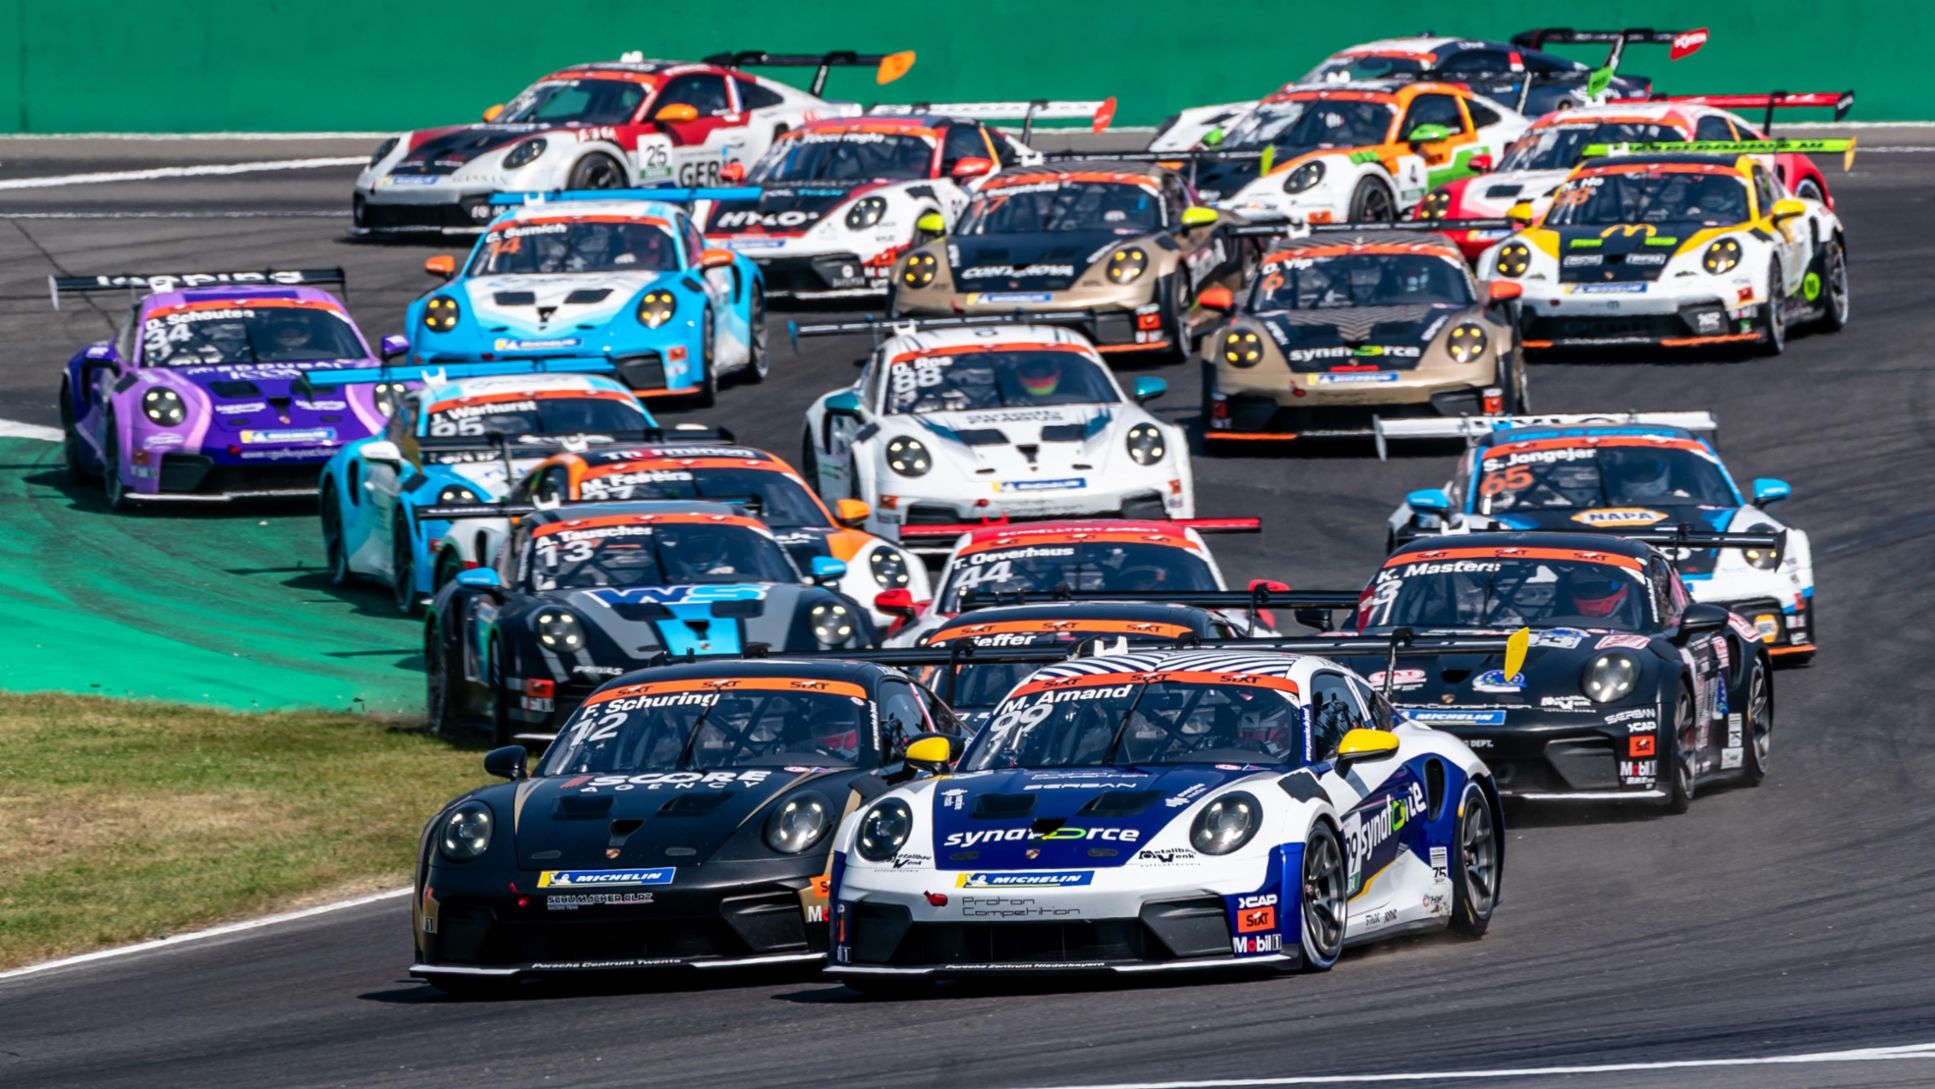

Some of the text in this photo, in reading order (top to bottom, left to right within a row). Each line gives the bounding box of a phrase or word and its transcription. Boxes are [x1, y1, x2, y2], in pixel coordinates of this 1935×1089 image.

[646, 144, 668, 169] 25
[1284, 258, 1314, 270] Yip
[146, 318, 166, 331] D.
[144, 324, 192, 352] 34
[892, 362, 913, 376] D.
[893, 367, 943, 393] 88
[1482, 456, 1505, 473] S.
[1480, 464, 1534, 496] 65
[1589, 511, 1654, 522] NAPA
[535, 535, 559, 548] A.
[536, 538, 594, 567] 13
[952, 546, 1074, 570] T. Oeverhaus
[953, 560, 1014, 589] 44
[1376, 560, 1501, 584] K. Masters
[972, 632, 1037, 647] ieffer
[580, 693, 721, 721] F. Schuring
[1001, 684, 1134, 715] M. Amand
[988, 703, 1054, 743] 99
[1415, 713, 1494, 721] MICHELIN
[570, 712, 629, 748] 12
[1470, 739, 1494, 748] DEPT.
[581, 781, 759, 793] AGENCY
[588, 770, 772, 787] SCORE
[575, 872, 663, 883] MICHELIN
[993, 874, 1082, 884] MICHELIN
[962, 896, 1035, 906] Proton
[962, 907, 1081, 918] Competition
[1232, 935, 1271, 954] Mobil
[582, 960, 635, 968] Centrum
